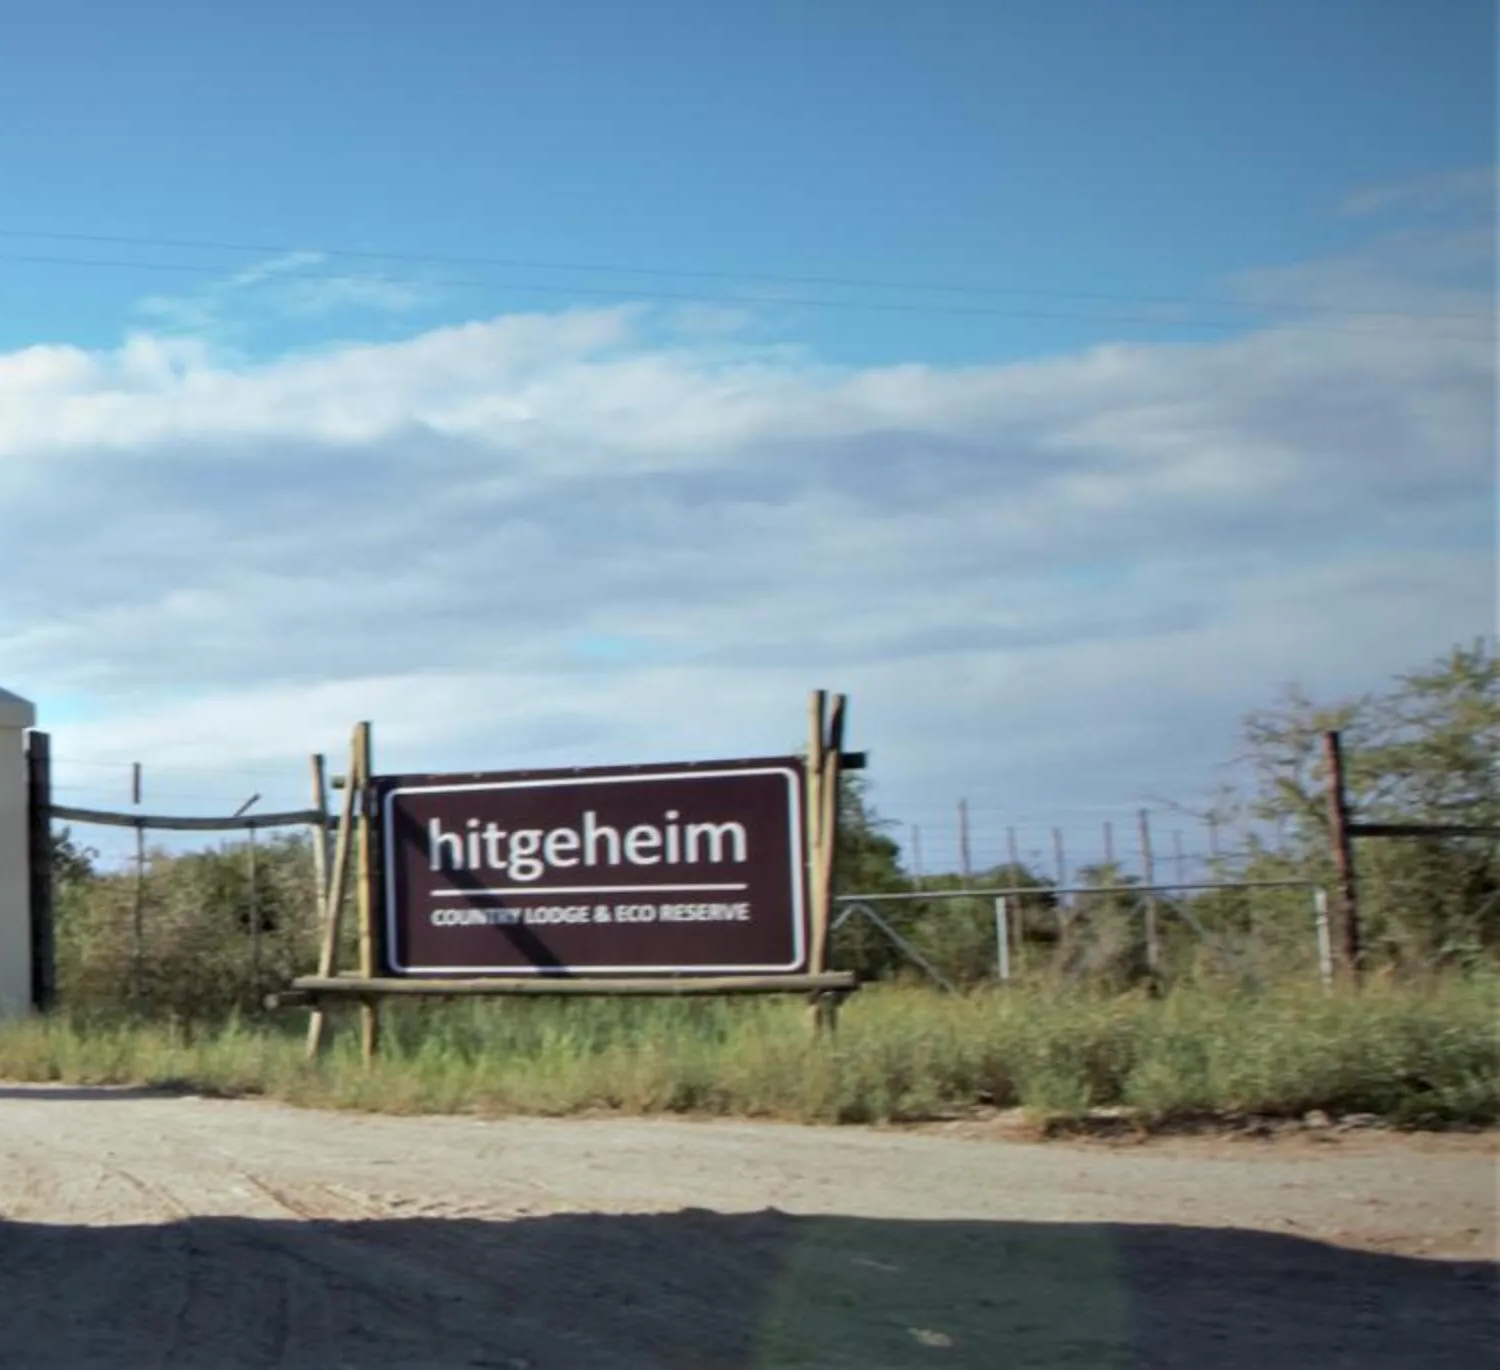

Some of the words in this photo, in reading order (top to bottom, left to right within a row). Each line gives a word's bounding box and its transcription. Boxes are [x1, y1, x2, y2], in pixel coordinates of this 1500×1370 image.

[428, 809, 748, 882] hitgeheim
[430, 908, 522, 927] COUNTRY
[524, 906, 591, 925] LODGE
[593, 905, 612, 924] &
[614, 904, 657, 923] ECO
[659, 902, 751, 922] RESERVE
